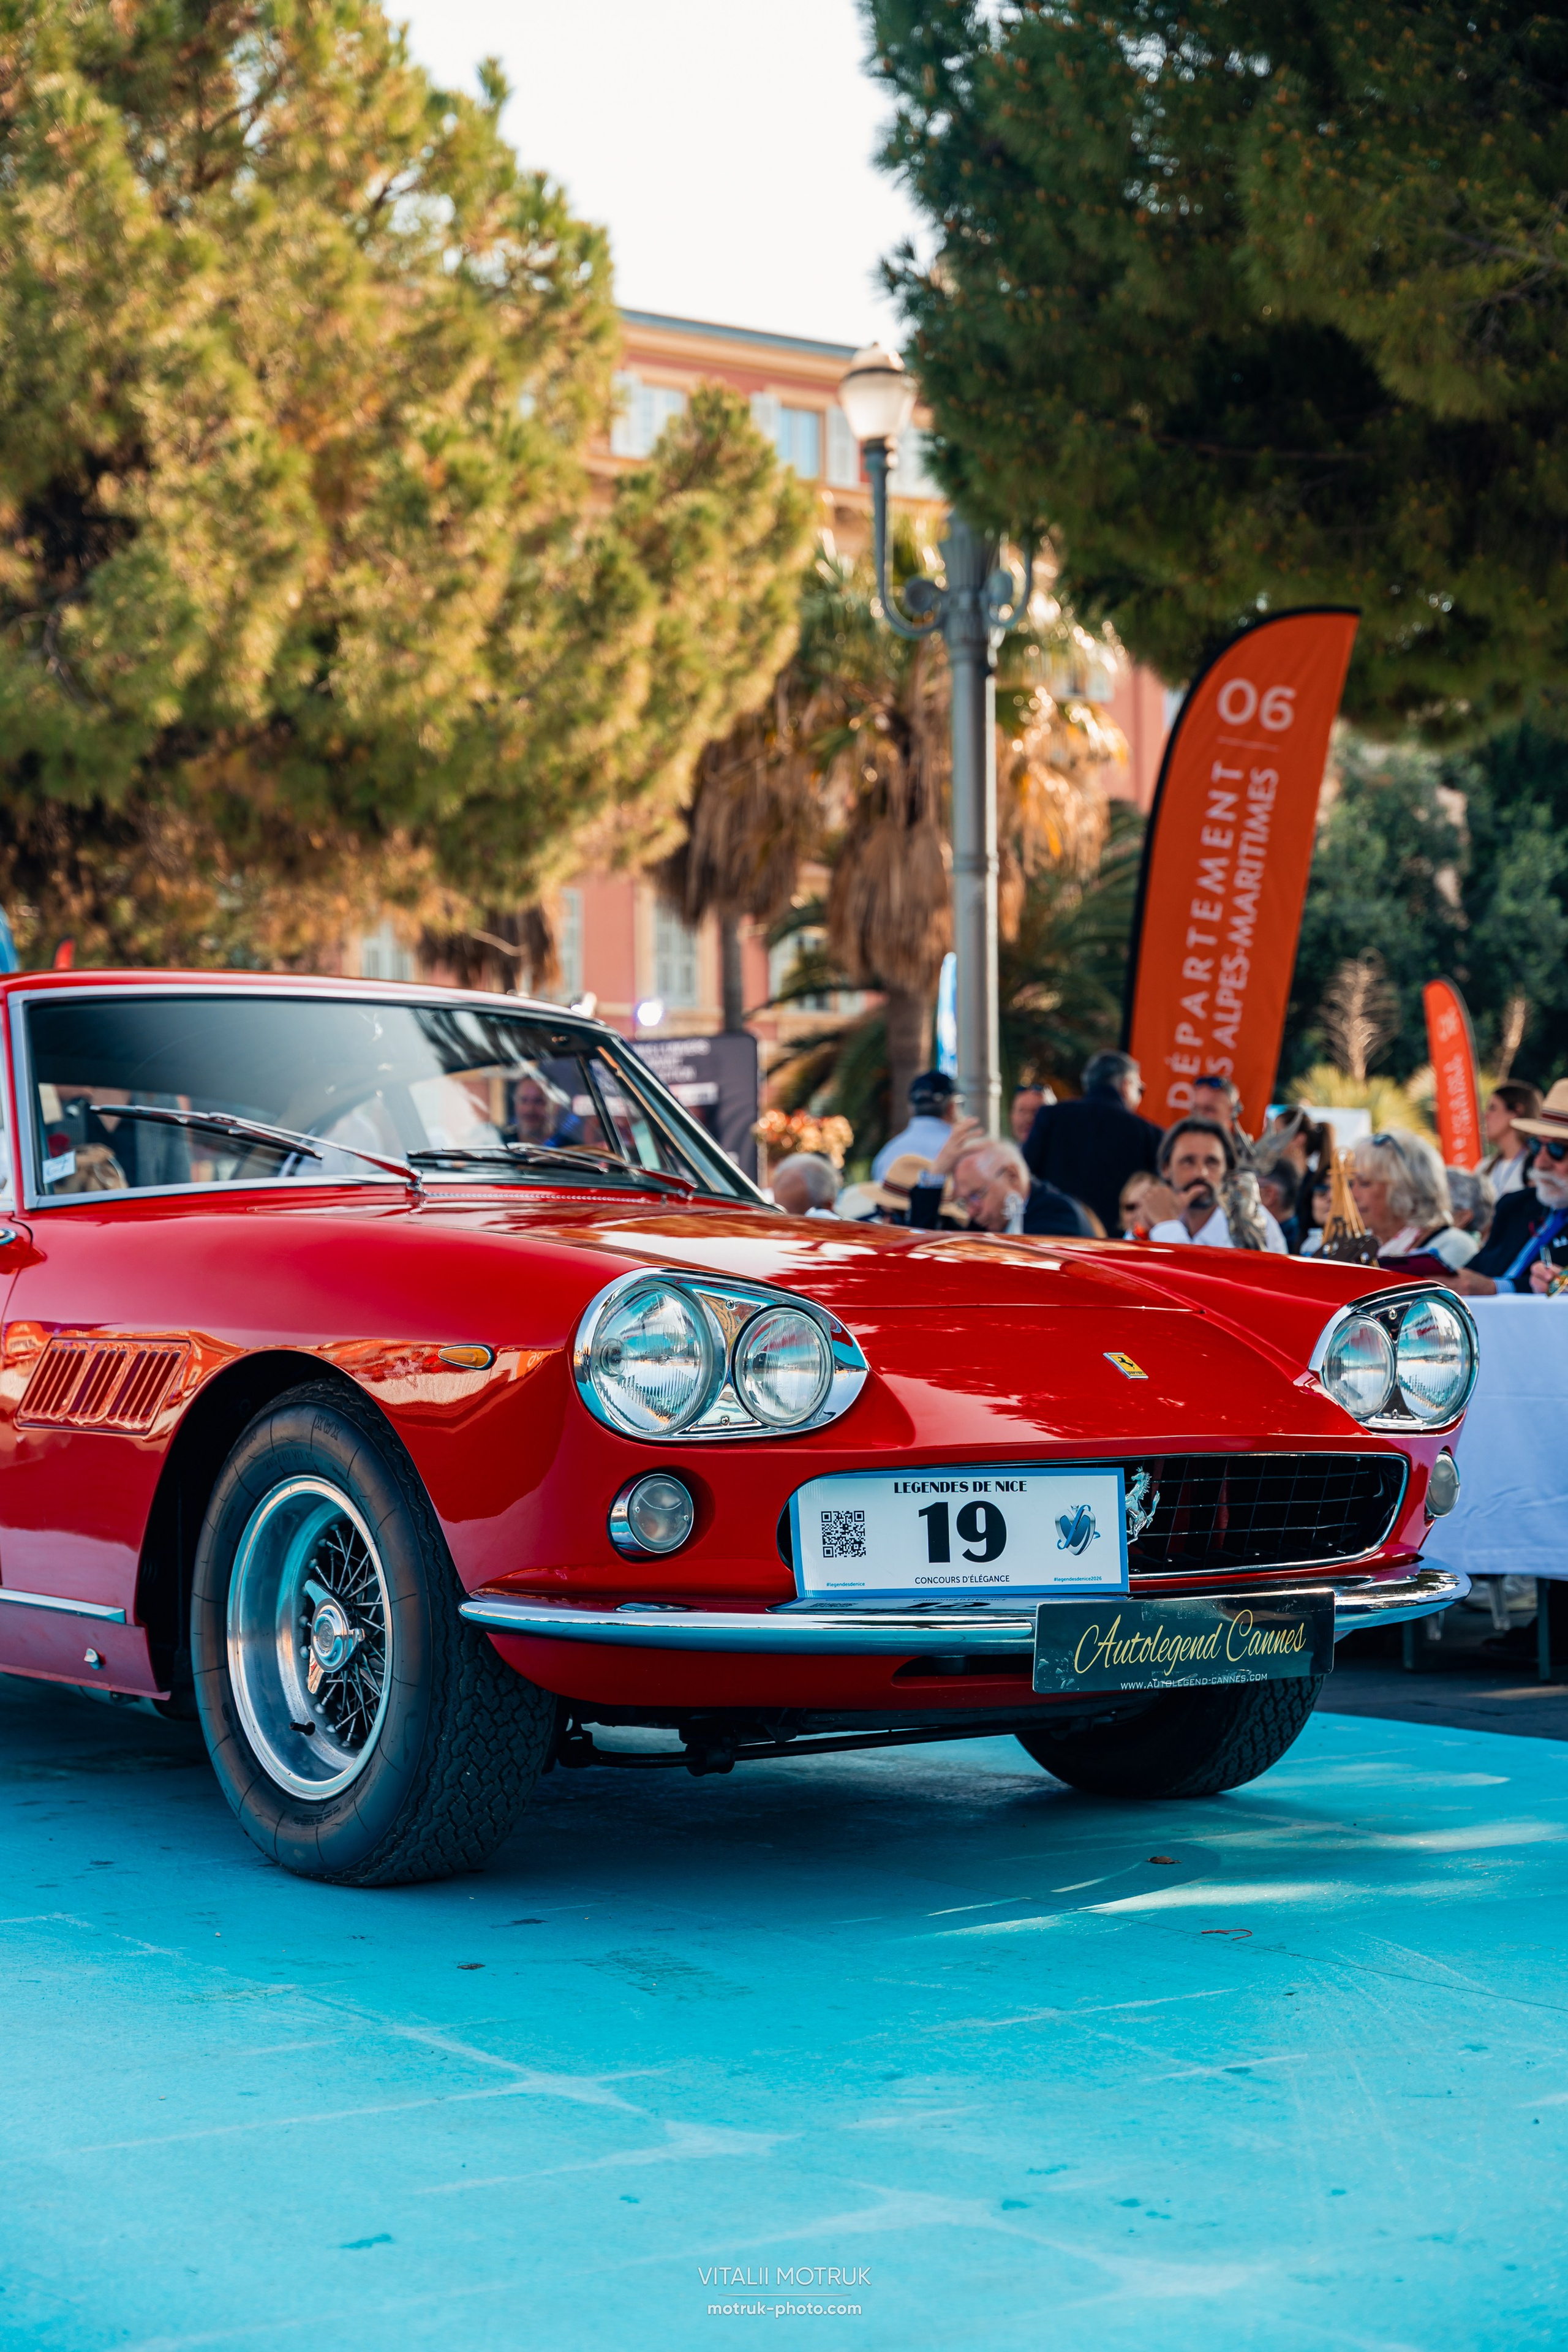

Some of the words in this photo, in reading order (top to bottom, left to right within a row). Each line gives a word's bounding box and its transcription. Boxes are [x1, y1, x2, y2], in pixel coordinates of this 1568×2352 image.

[1216, 677, 1297, 731] 06
[1164, 760, 1243, 1110] DÉPARTEMENT
[1212, 767, 1280, 1049] ALPES-MARITIMES
[314, 1414, 343, 1441] XWX
[894, 1481, 969, 1493] LEGENDES
[973, 1480, 992, 1493] DE
[995, 1480, 1027, 1492] NICE
[918, 1500, 1007, 1563] 19
[962, 1574, 1010, 1583] D'ÉLÉGANCE
[1074, 1614, 1221, 1676] Autolegend
[1226, 1609, 1306, 1662] Cannes
[1120, 1673, 1268, 1691] WWW.AUTOLEGEND-CANNES.COM
